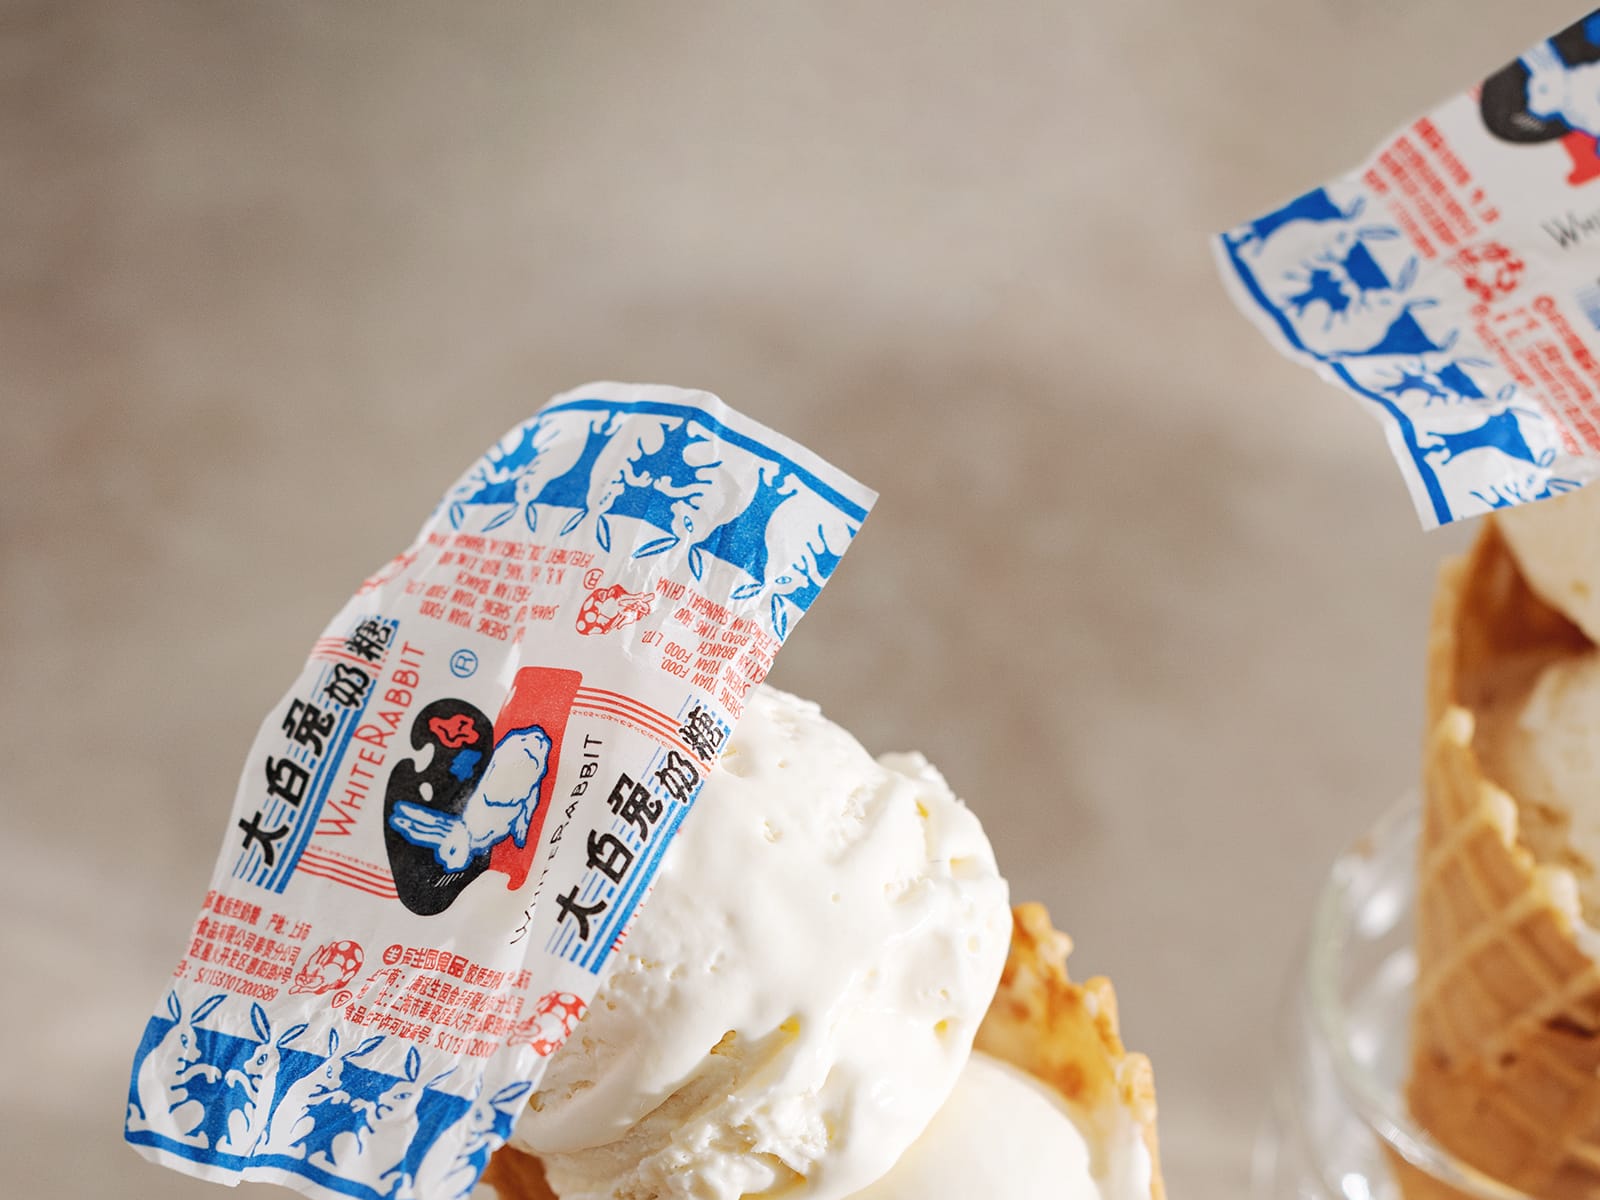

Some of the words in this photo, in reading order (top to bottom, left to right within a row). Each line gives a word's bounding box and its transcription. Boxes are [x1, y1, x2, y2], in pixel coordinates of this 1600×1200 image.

[656, 577, 686, 601] CHINA
[686, 589, 731, 626] SHANGHAI,
[664, 642, 693, 663] FOOD
[697, 641, 738, 660] BRANCH
[694, 657, 721, 675] YUAN
[691, 672, 718, 694] YUAN
[722, 666, 751, 698] SHENG
[719, 687, 744, 721] SHENG
[238, 621, 391, 867] 大白兔奶糖
[556, 706, 723, 941] 大白兔奶糖
